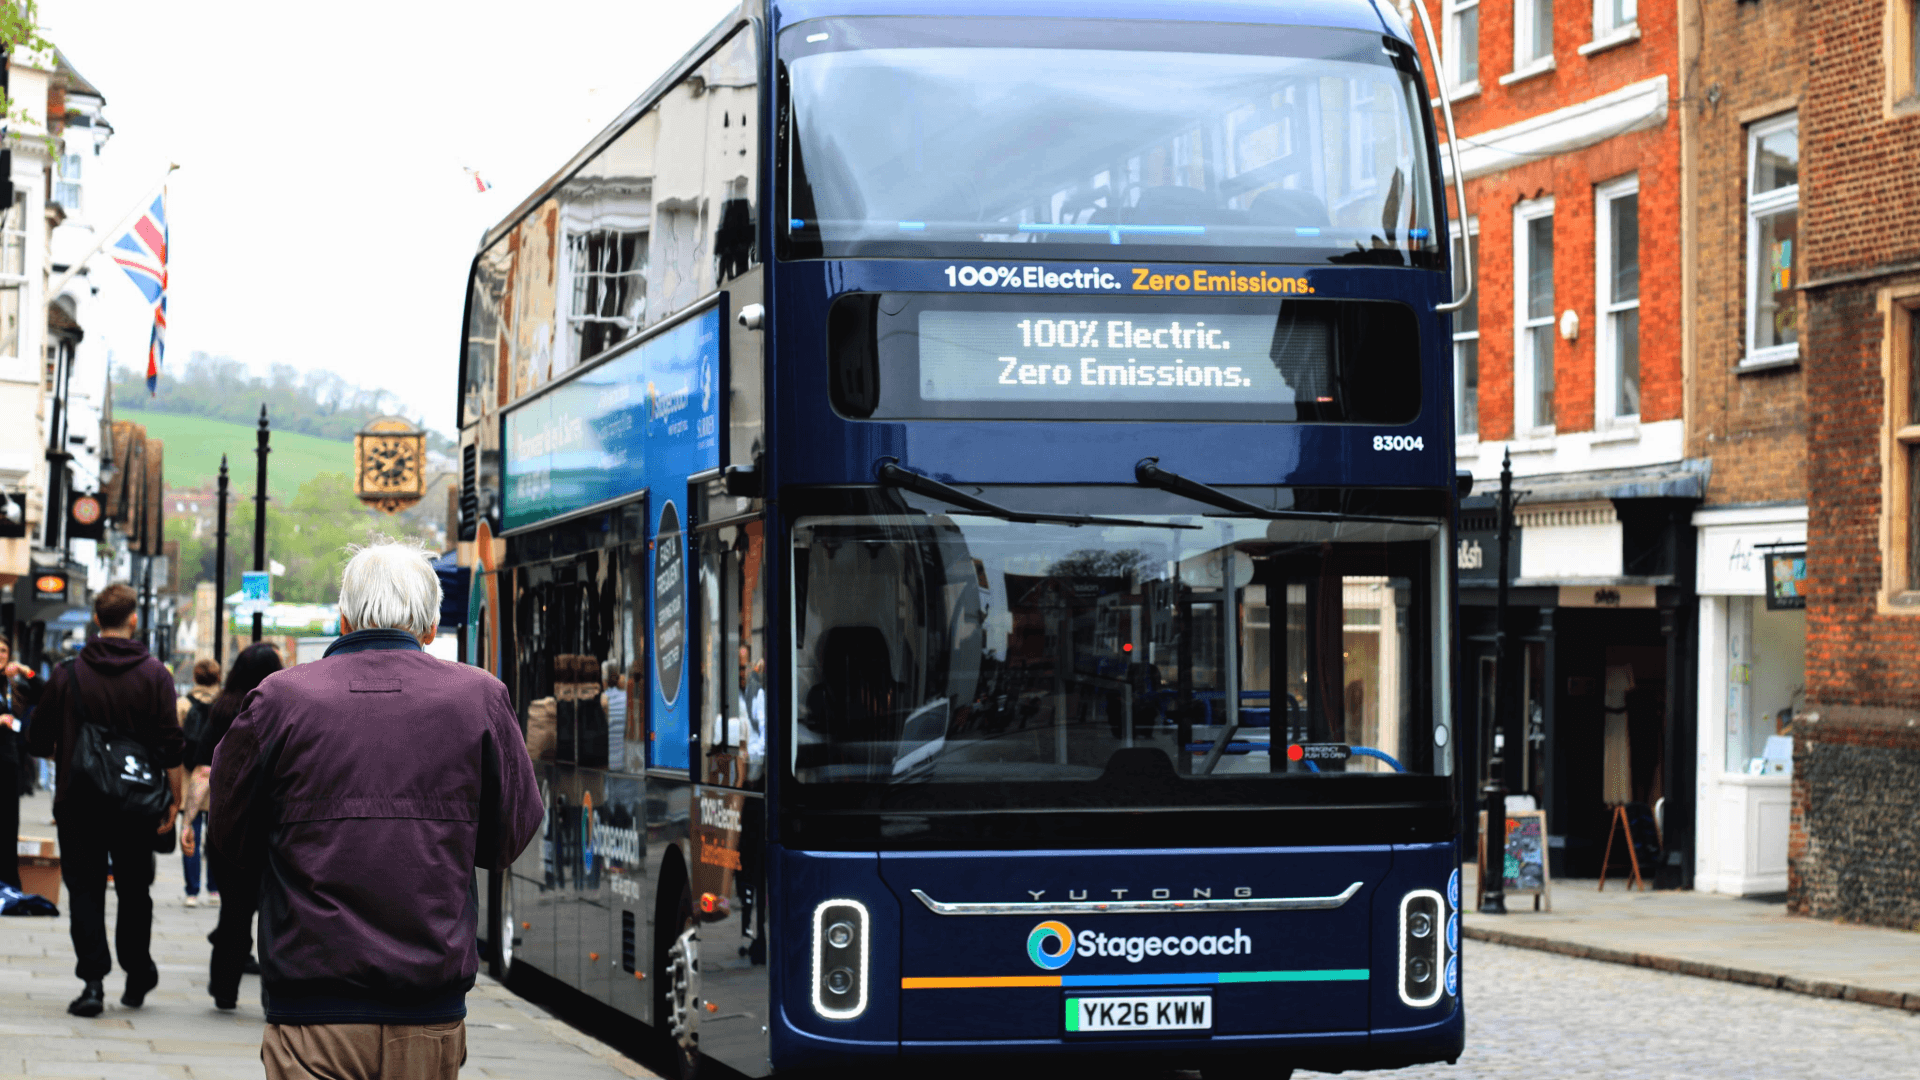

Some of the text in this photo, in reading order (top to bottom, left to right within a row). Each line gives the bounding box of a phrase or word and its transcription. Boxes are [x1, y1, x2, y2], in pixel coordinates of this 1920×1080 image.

[1131, 268, 1191, 292] Zero
[1193, 269, 1315, 294] Emissions.
[1017, 319, 1230, 350] 100% Electric.
[998, 356, 1251, 387] Zero Emissions.
[1372, 435, 1424, 451] 83004
[1028, 887, 1252, 900] YUTONG
[1077, 928, 1251, 963] Stagecoach
[1084, 1002, 1205, 1026] YK26 KWW
